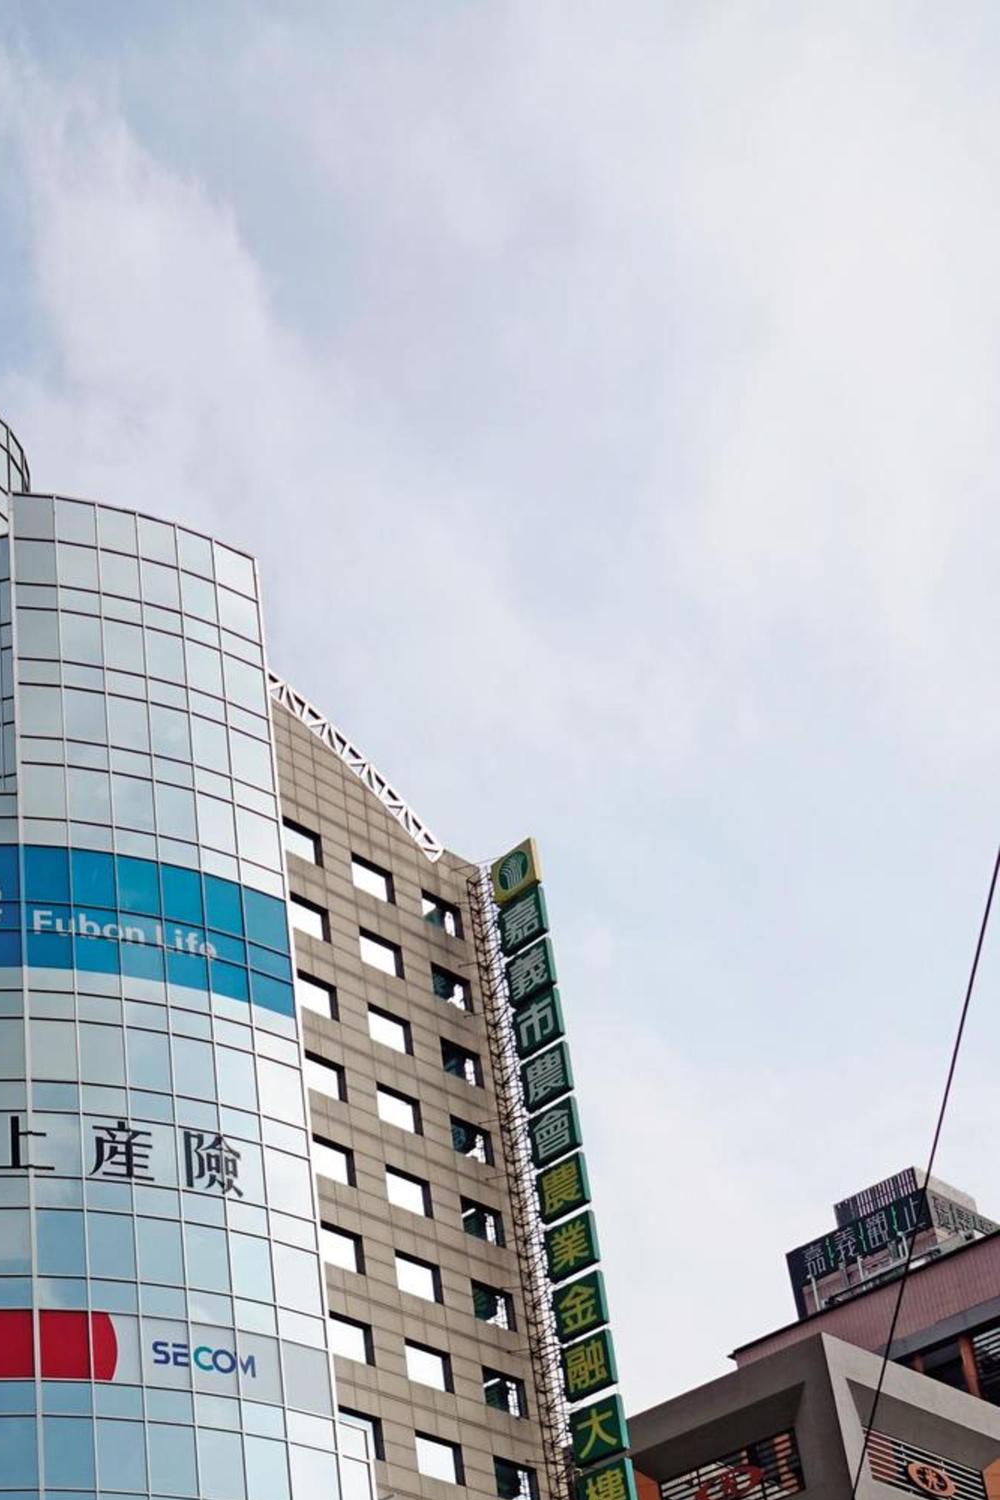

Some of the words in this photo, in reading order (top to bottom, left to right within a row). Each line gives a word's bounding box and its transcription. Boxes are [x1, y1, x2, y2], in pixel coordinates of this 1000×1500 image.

[33, 909, 145, 945] Fubon
[155, 924, 217, 959] Life
[152, 1340, 257, 1379] SECOM
